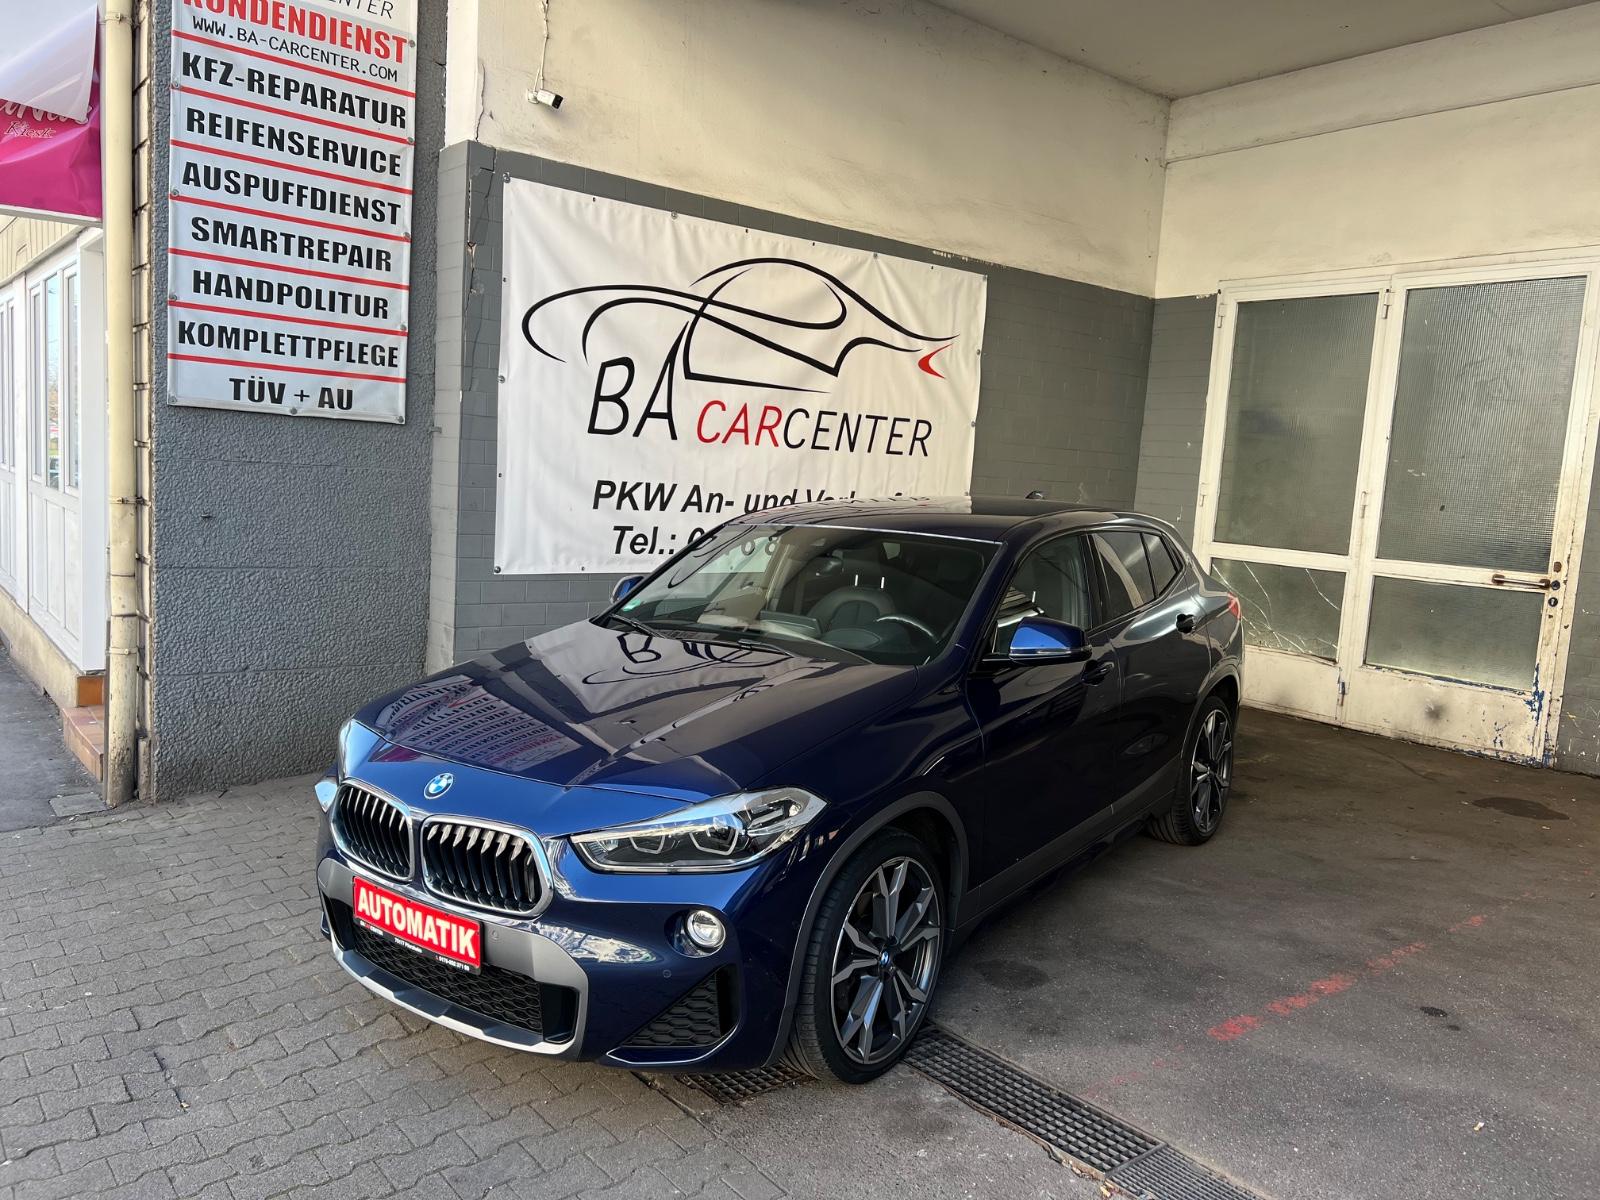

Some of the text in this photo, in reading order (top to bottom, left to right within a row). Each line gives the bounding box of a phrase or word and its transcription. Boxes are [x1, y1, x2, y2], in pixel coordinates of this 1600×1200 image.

[192, 15, 398, 83] WWW.BA-CARCENTER.COM
[182, 51, 406, 129] KFZ-REPARATUR
[186, 107, 401, 177] REIFENSERVICE
[181, 161, 401, 225] AUSPUFFDIENST
[191, 216, 392, 272] SMARTREPAIR
[192, 269, 389, 319] HANDPOLITUR
[178, 320, 399, 368] KOMPLETTPFLEGE
[228, 375, 354, 411] TÜV + AU
[587, 321, 934, 458] BA CARCENTER
[592, 479, 678, 513] PKW
[680, 483, 735, 514] An-
[612, 525, 677, 556] Tel.:
[357, 886, 477, 960] AUTOMATIK
